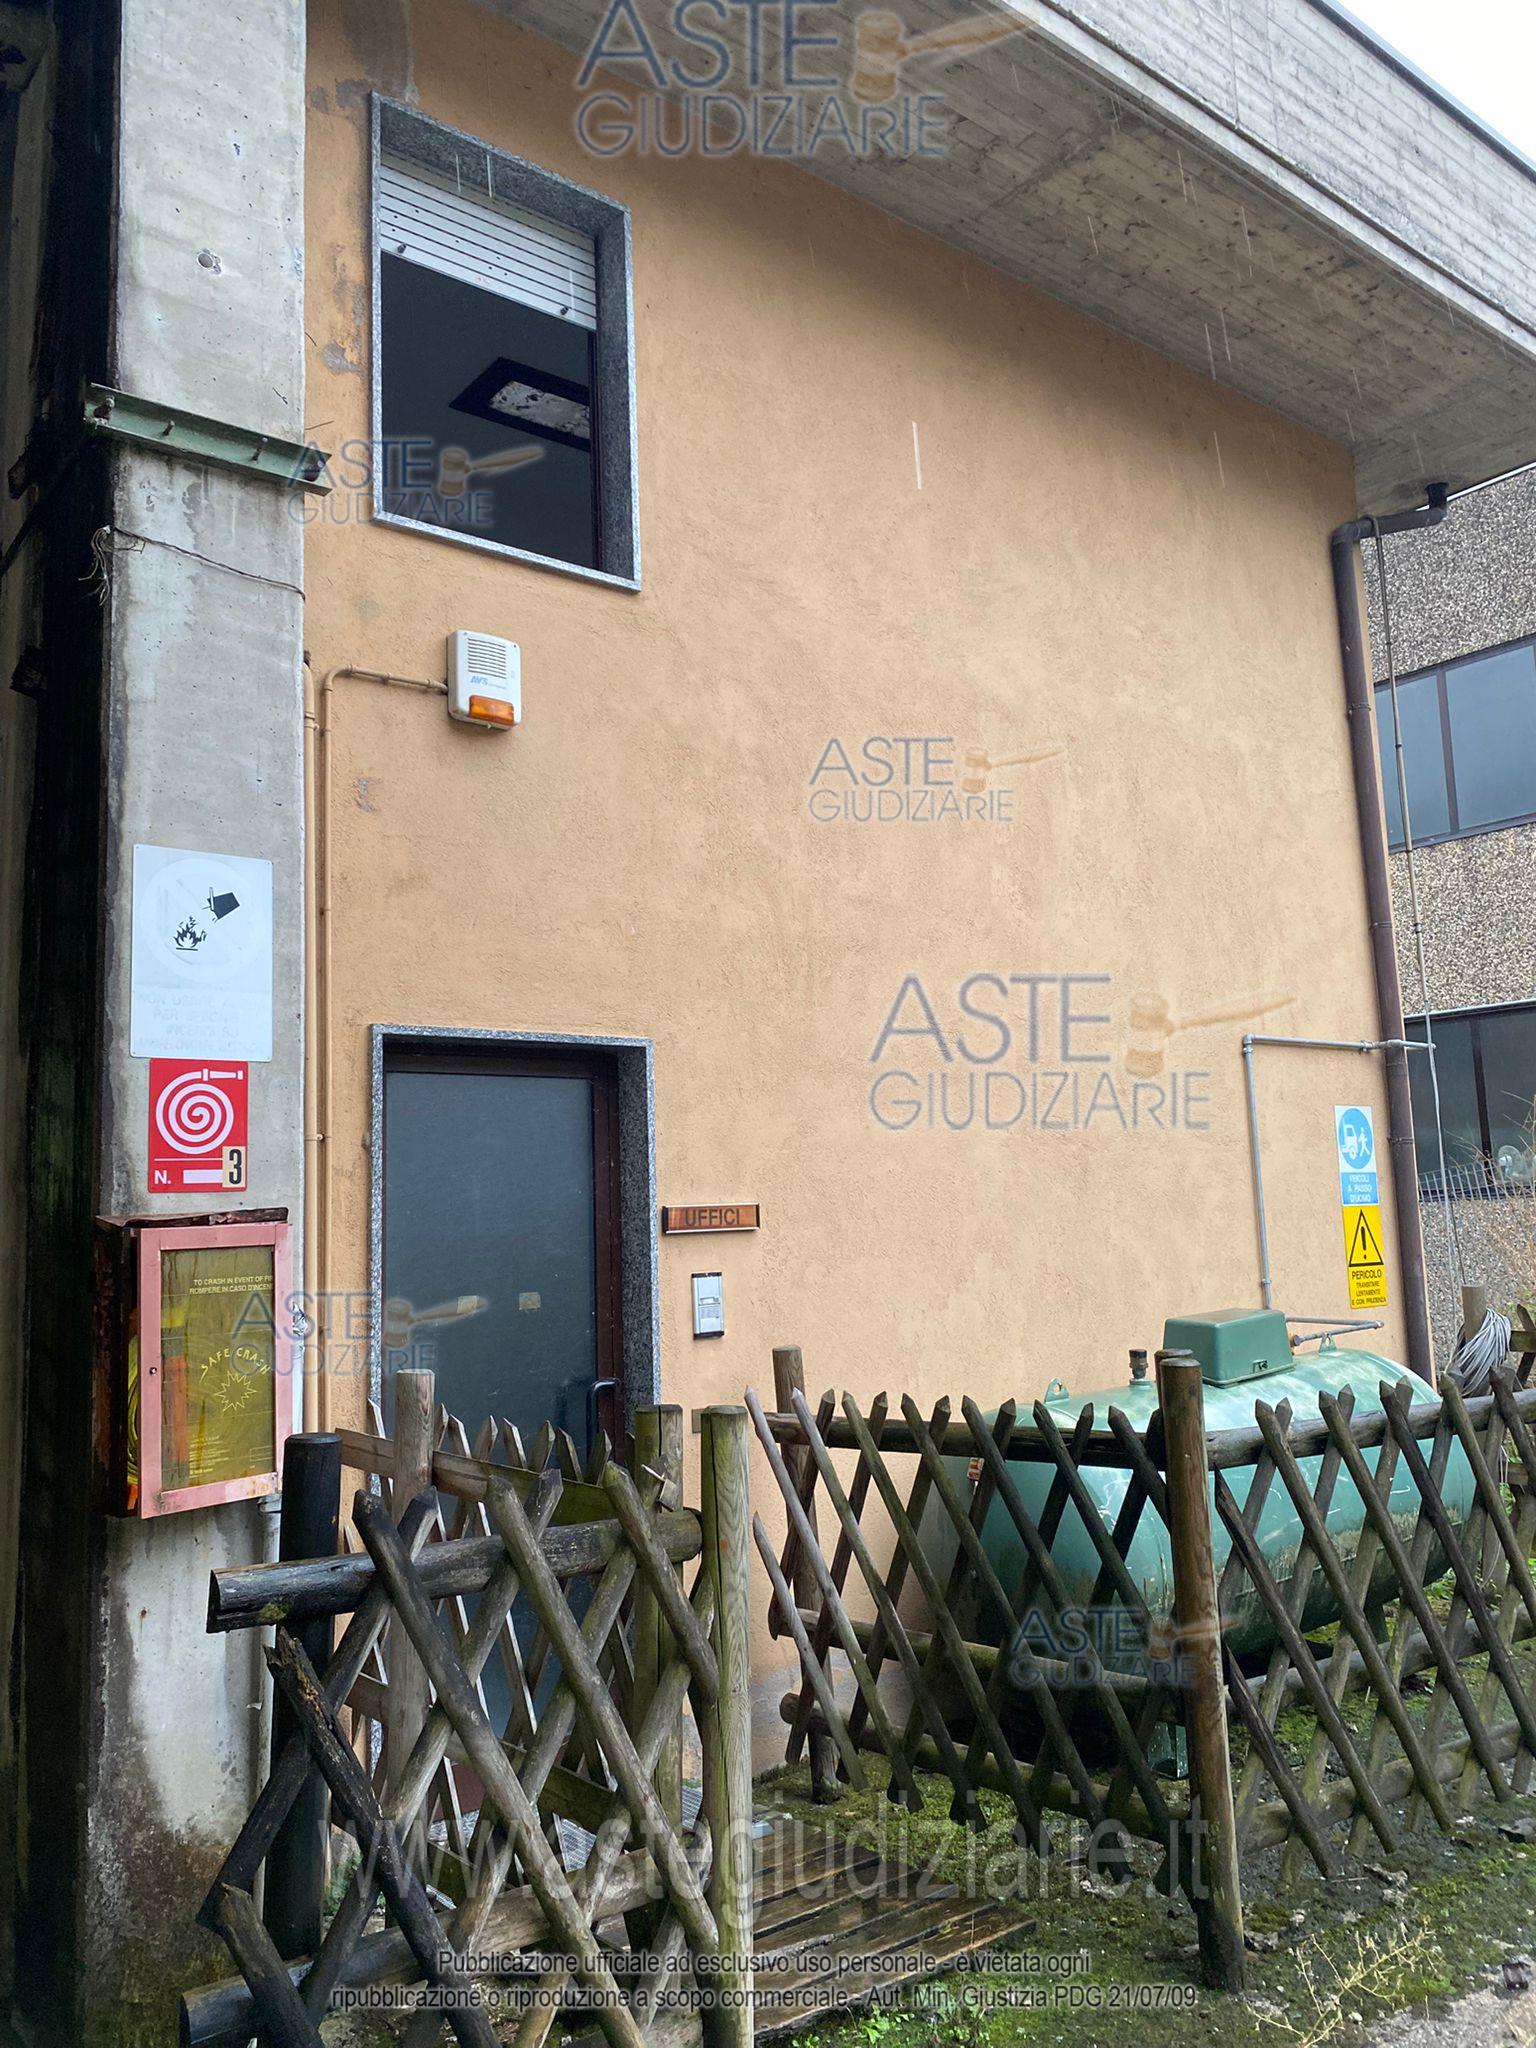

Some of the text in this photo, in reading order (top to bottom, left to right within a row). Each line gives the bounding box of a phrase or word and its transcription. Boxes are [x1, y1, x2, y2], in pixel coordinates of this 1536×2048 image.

[228, 1148, 243, 1185] 3
[154, 1169, 172, 1185] N.
[685, 1208, 740, 1227] UFFICI
[203, 1278, 226, 1286] CRASH
[234, 1276, 254, 1284] EVENT
[1352, 1269, 1382, 1280] PERICOLO
[189, 1287, 221, 1295] ROMPERE
[229, 1284, 247, 1292] CASO
[200, 1347, 271, 1383] SAFE CRASH
